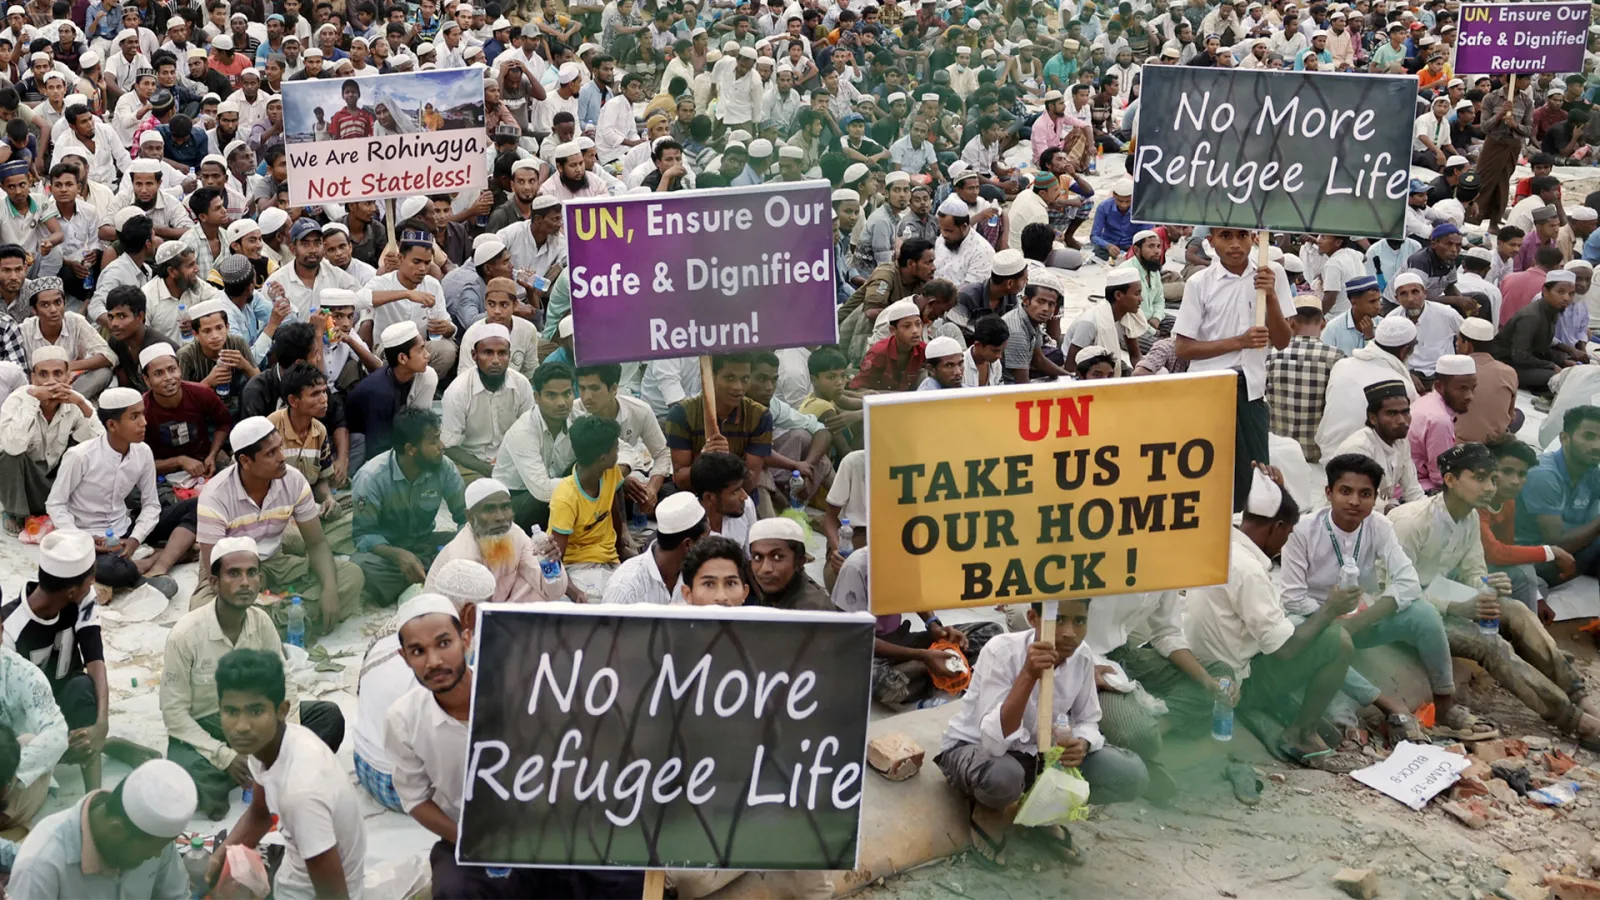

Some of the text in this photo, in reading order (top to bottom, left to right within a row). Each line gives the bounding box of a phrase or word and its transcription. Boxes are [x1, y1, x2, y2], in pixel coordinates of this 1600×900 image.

[1458, 30, 1586, 49] Safe & Dignified
[1465, 6, 1588, 24] UN, Ensure Our
[1491, 56, 1547, 70] Return!
[1173, 91, 1376, 141] No More
[290, 135, 485, 169] We Are Rohingya,
[1134, 141, 1408, 204] Refugee Life
[307, 165, 472, 200] Not Stateless!
[575, 195, 825, 244] UN, Ensure Our
[571, 249, 830, 299] Safe & Dignified
[649, 311, 760, 351] Return!
[1015, 395, 1094, 442] UN
[889, 438, 1215, 505] TAKE US TO
[901, 490, 1201, 556] OUR HOME
[960, 548, 1138, 601] BACK !
[528, 649, 819, 720] No More
[465, 729, 862, 827] Refugee Life
[1410, 760, 1452, 795] CAMP-18
